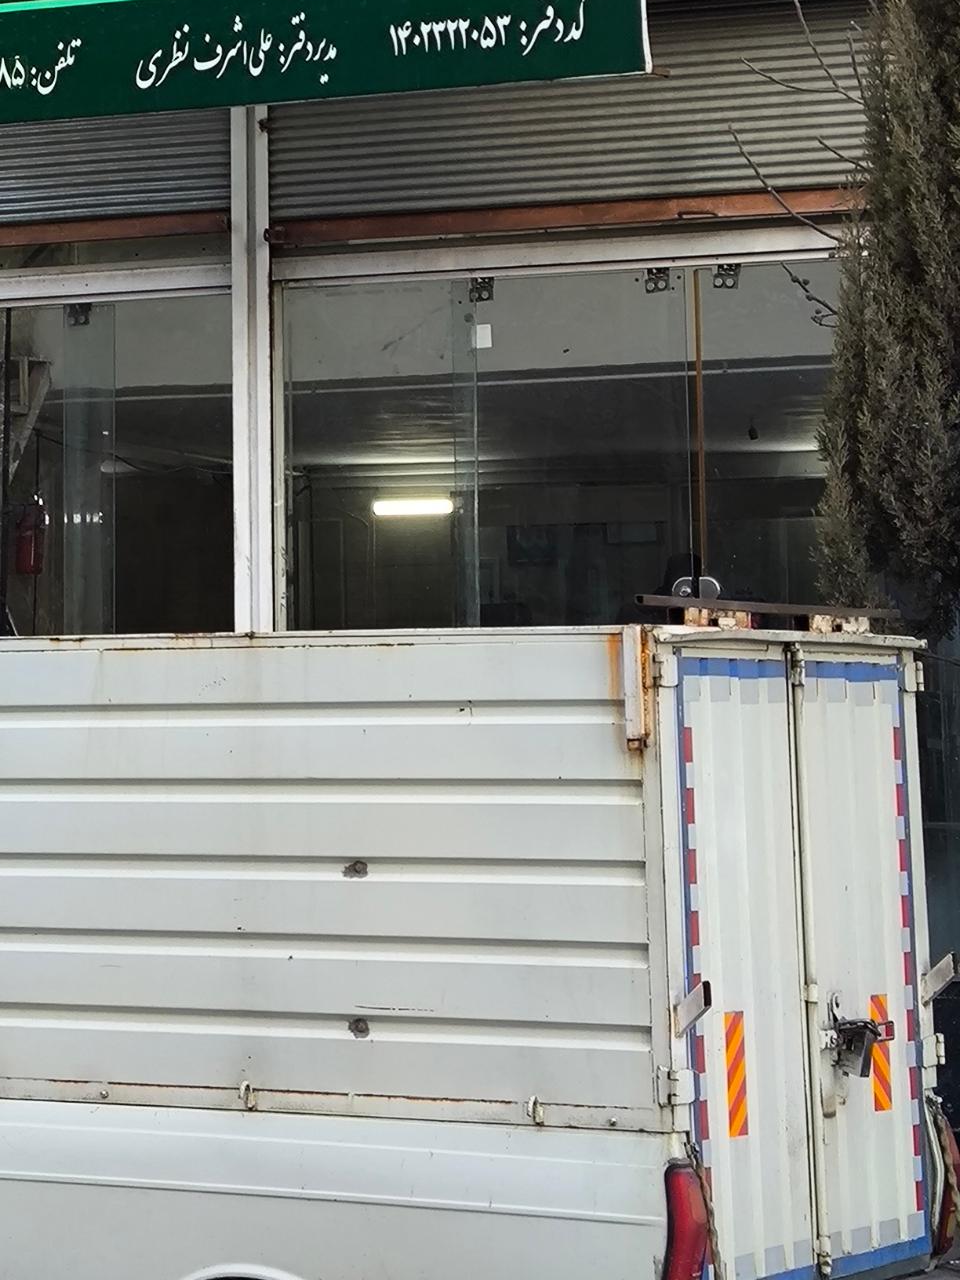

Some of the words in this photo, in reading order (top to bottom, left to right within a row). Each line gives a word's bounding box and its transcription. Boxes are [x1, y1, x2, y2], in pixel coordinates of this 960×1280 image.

[135, 23, 191, 90] نظری
[248, 27, 274, 77] علی
[313, 37, 338, 85] مدیر
